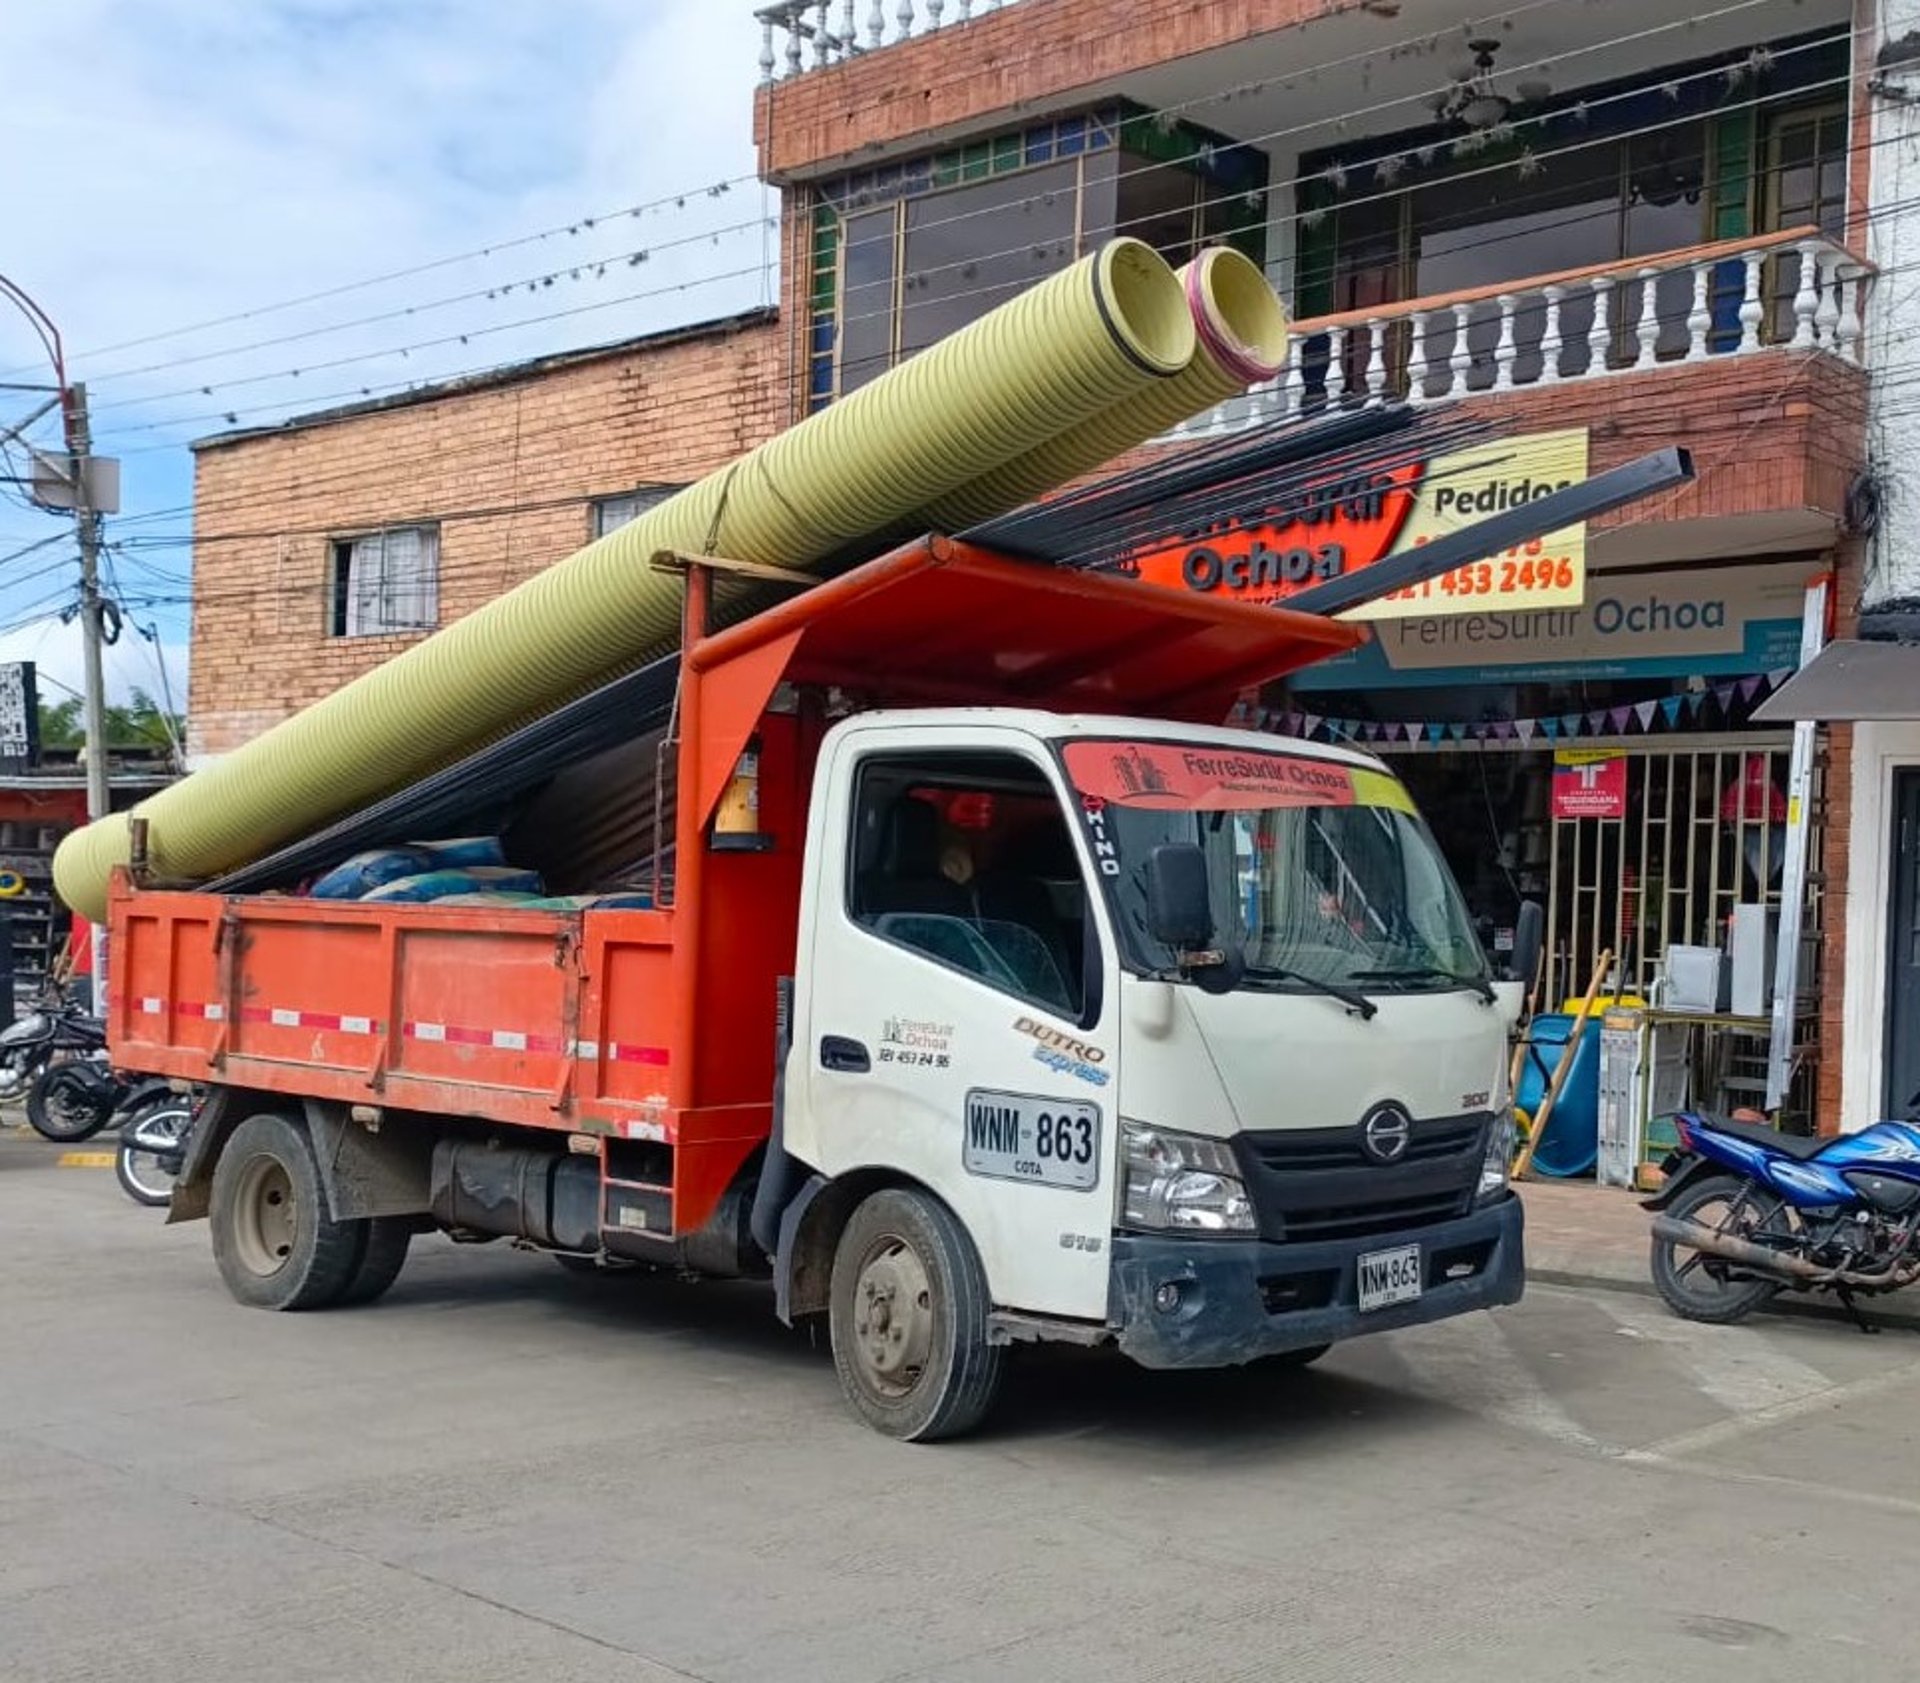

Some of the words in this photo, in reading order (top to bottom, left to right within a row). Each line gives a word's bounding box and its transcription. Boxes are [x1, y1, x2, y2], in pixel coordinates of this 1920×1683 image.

[1183, 542, 1346, 592] Ochoa
[1440, 563, 1492, 596] 453
[1500, 557, 1573, 592] 2496
[1400, 608, 1581, 645] FerreSurtir
[1594, 596, 1725, 635] Ochoa
[1182, 753, 1282, 780] FerreSurtir
[1288, 764, 1349, 790] Ochoa
[1086, 811, 1120, 876] HINO
[905, 1033, 948, 1050] Ochoa
[1013, 1016, 1106, 1062] DUTRO
[969, 1103, 1020, 1155] WNM
[1036, 1112, 1093, 1165] 863
[1014, 1160, 1043, 1176] COTA
